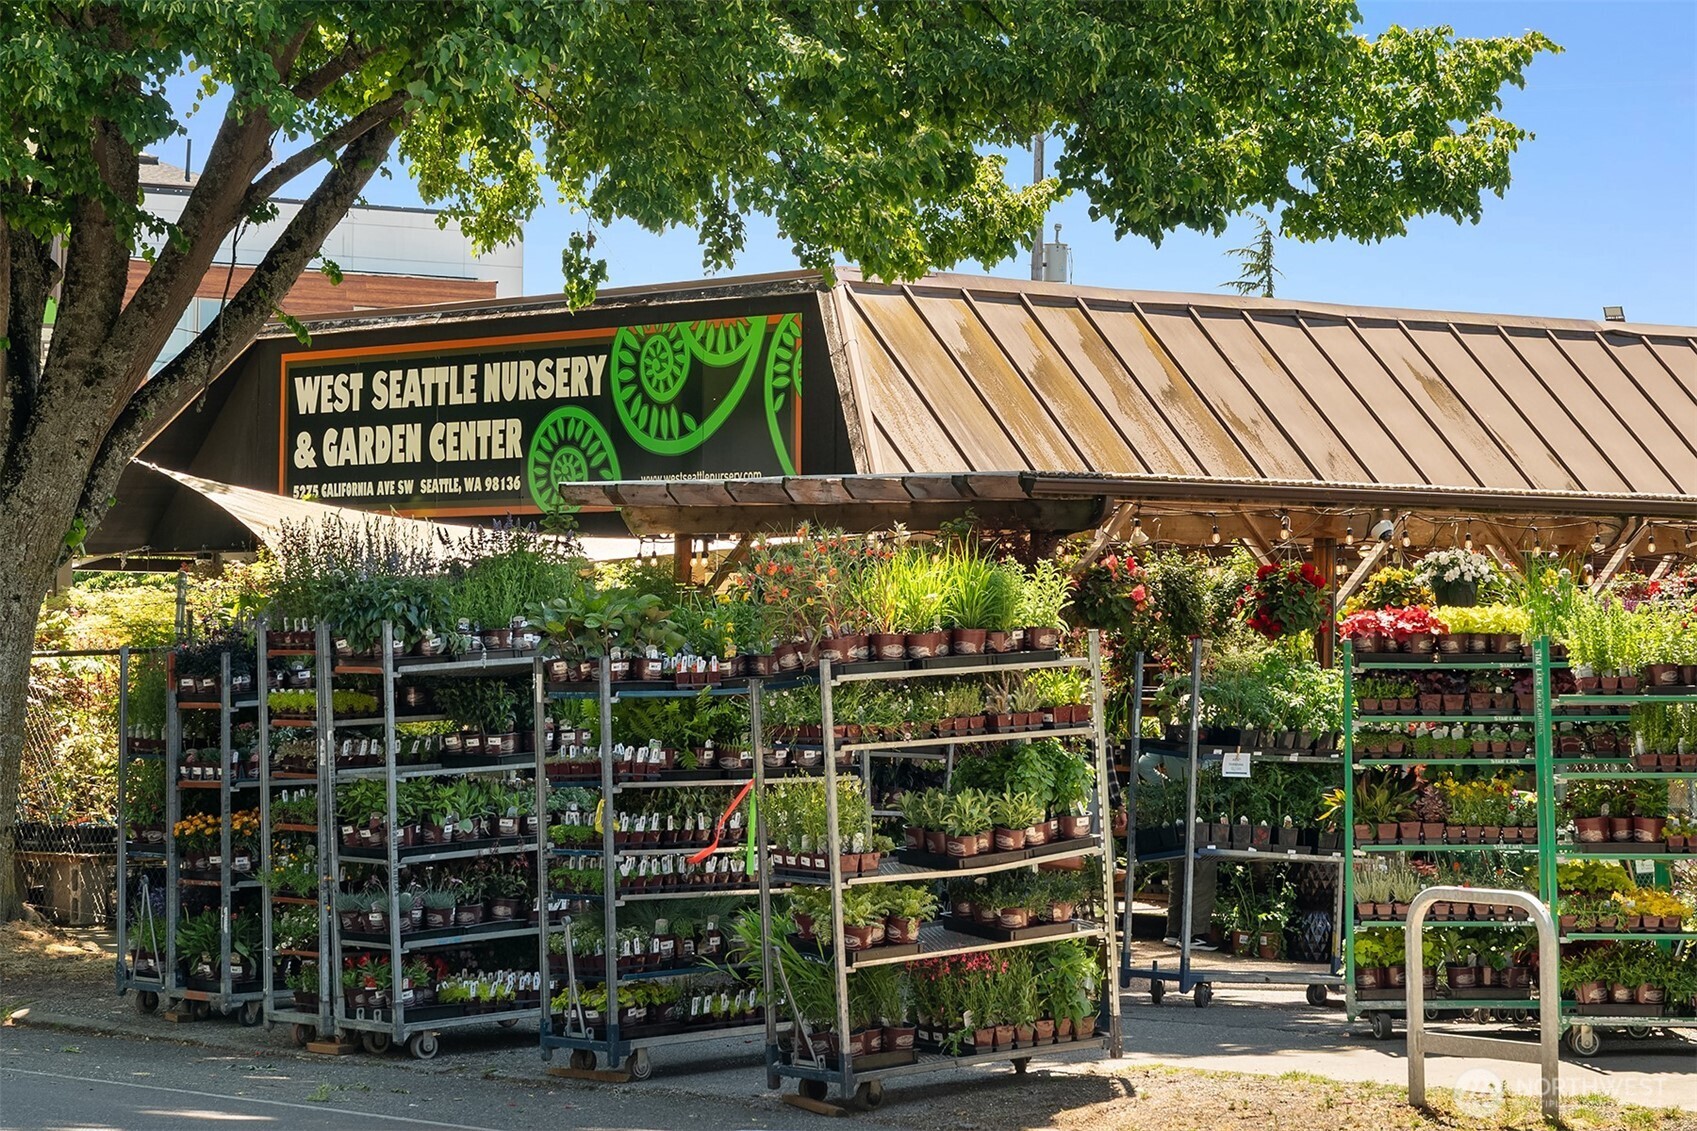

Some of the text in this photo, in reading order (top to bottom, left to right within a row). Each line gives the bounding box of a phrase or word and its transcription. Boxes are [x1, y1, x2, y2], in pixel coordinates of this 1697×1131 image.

[294, 354, 607, 415] WEST SEATTLE NURSERY
[294, 418, 523, 469] & GARDEN CENTER
[293, 475, 521, 499] 5275 CALIFORNIA AVE SW SEATTLE, WA 98136
[641, 470, 762, 481] wwwwestseattlenurserycom
